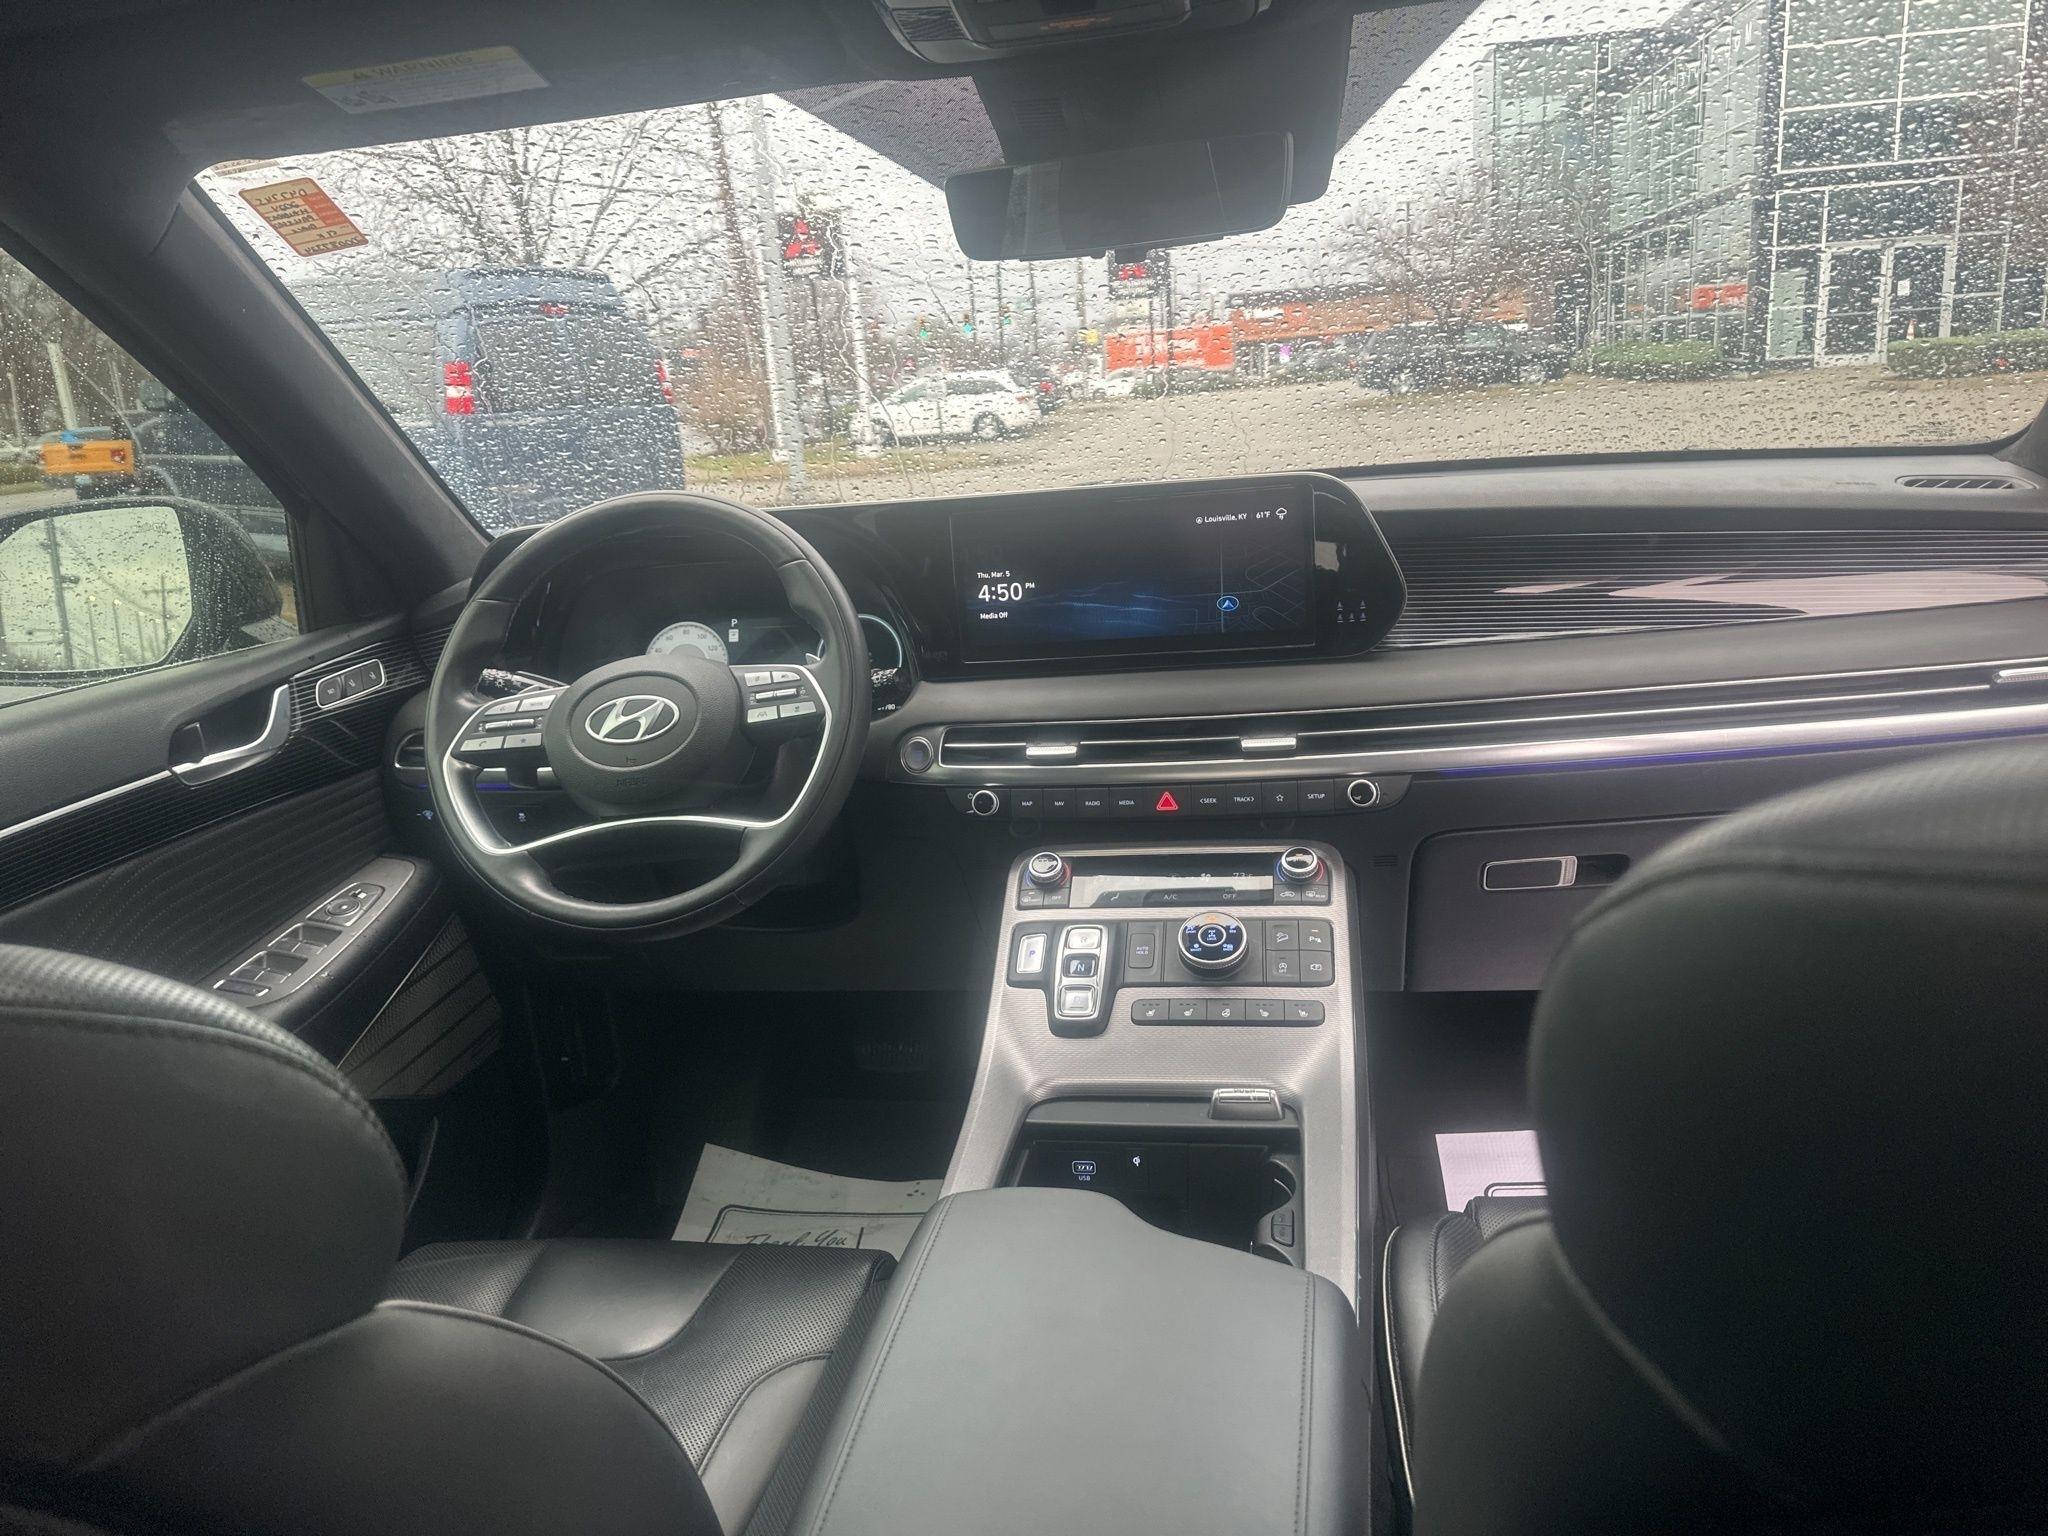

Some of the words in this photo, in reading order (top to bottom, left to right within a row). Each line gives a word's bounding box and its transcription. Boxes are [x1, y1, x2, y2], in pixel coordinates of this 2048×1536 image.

[372, 54, 473, 79] WARNING
[1205, 514, 1238, 523] Louisville,
[978, 582, 1023, 602] 4:50
[731, 618, 738, 627] P
[1077, 964, 1085, 972] N
